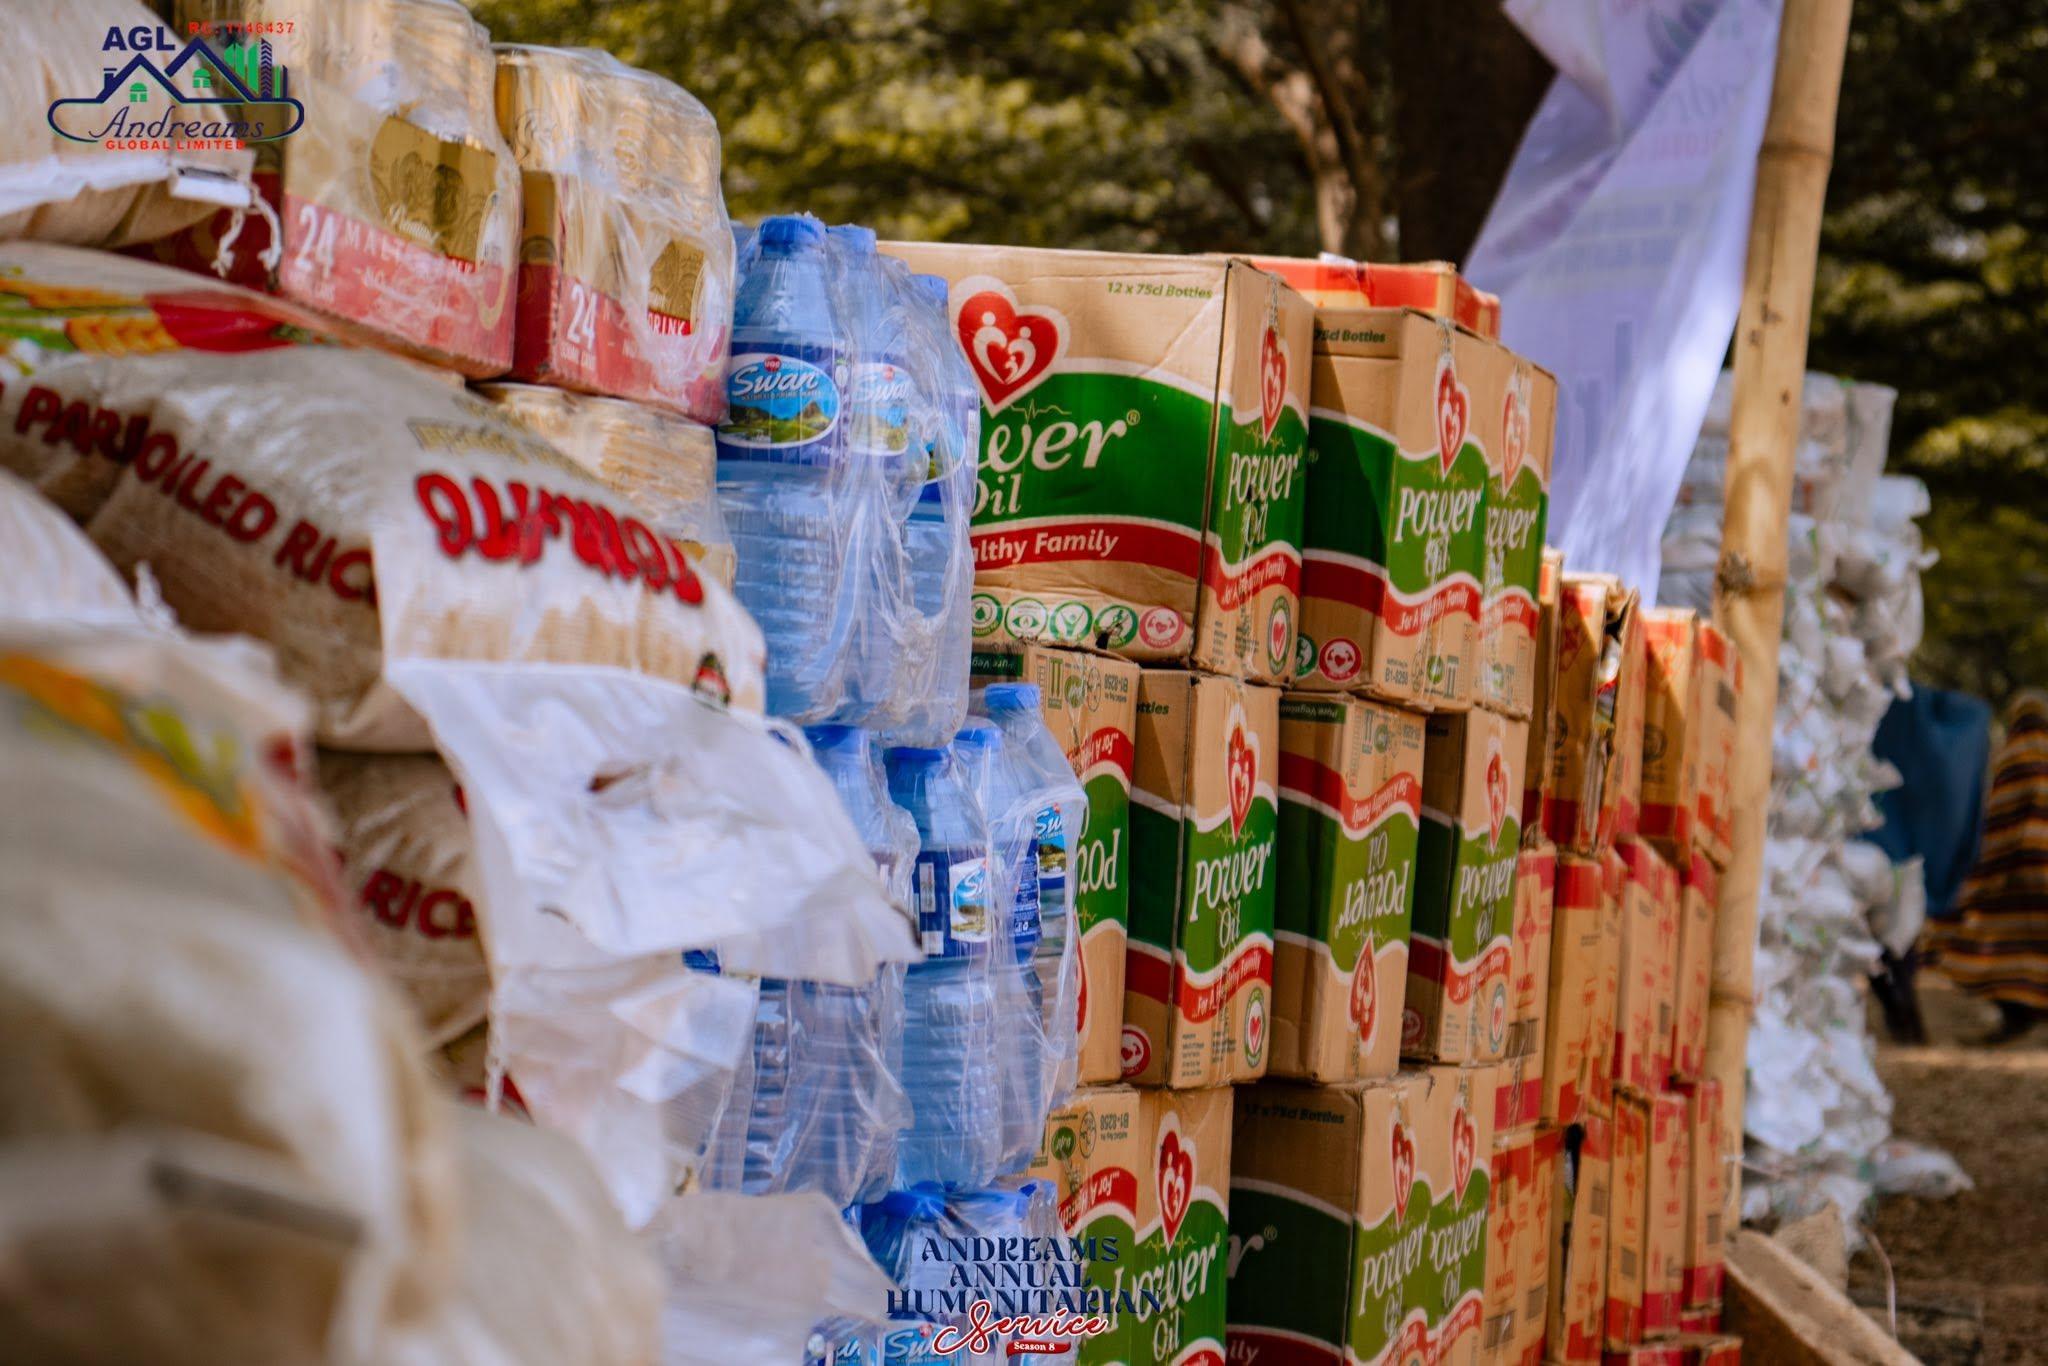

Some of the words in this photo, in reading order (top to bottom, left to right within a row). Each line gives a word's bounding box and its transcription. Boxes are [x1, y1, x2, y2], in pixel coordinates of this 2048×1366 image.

[294, 204, 337, 279] 24
[567, 284, 598, 350] 24
[1107, 282, 1121, 294] 12
[1124, 285, 1133, 295] x
[1136, 282, 1164, 297] 75cl
[1166, 283, 1213, 299] Bottles
[1342, 330, 1386, 343] Bottles
[731, 365, 819, 397] Swan
[1225, 452, 1300, 511] Power
[1393, 482, 1484, 543] Power
[1035, 529, 1119, 557] Family
[1446, 587, 1470, 611] Family
[1189, 842, 1272, 923] Power
[1338, 859, 1411, 931] Power
[1455, 857, 1517, 918] Power
[1241, 948, 1262, 980] Family
[1299, 1108, 1345, 1124] Bottles
[1361, 1218, 1430, 1318] Power
[1153, 1306, 1180, 1362] Oil
